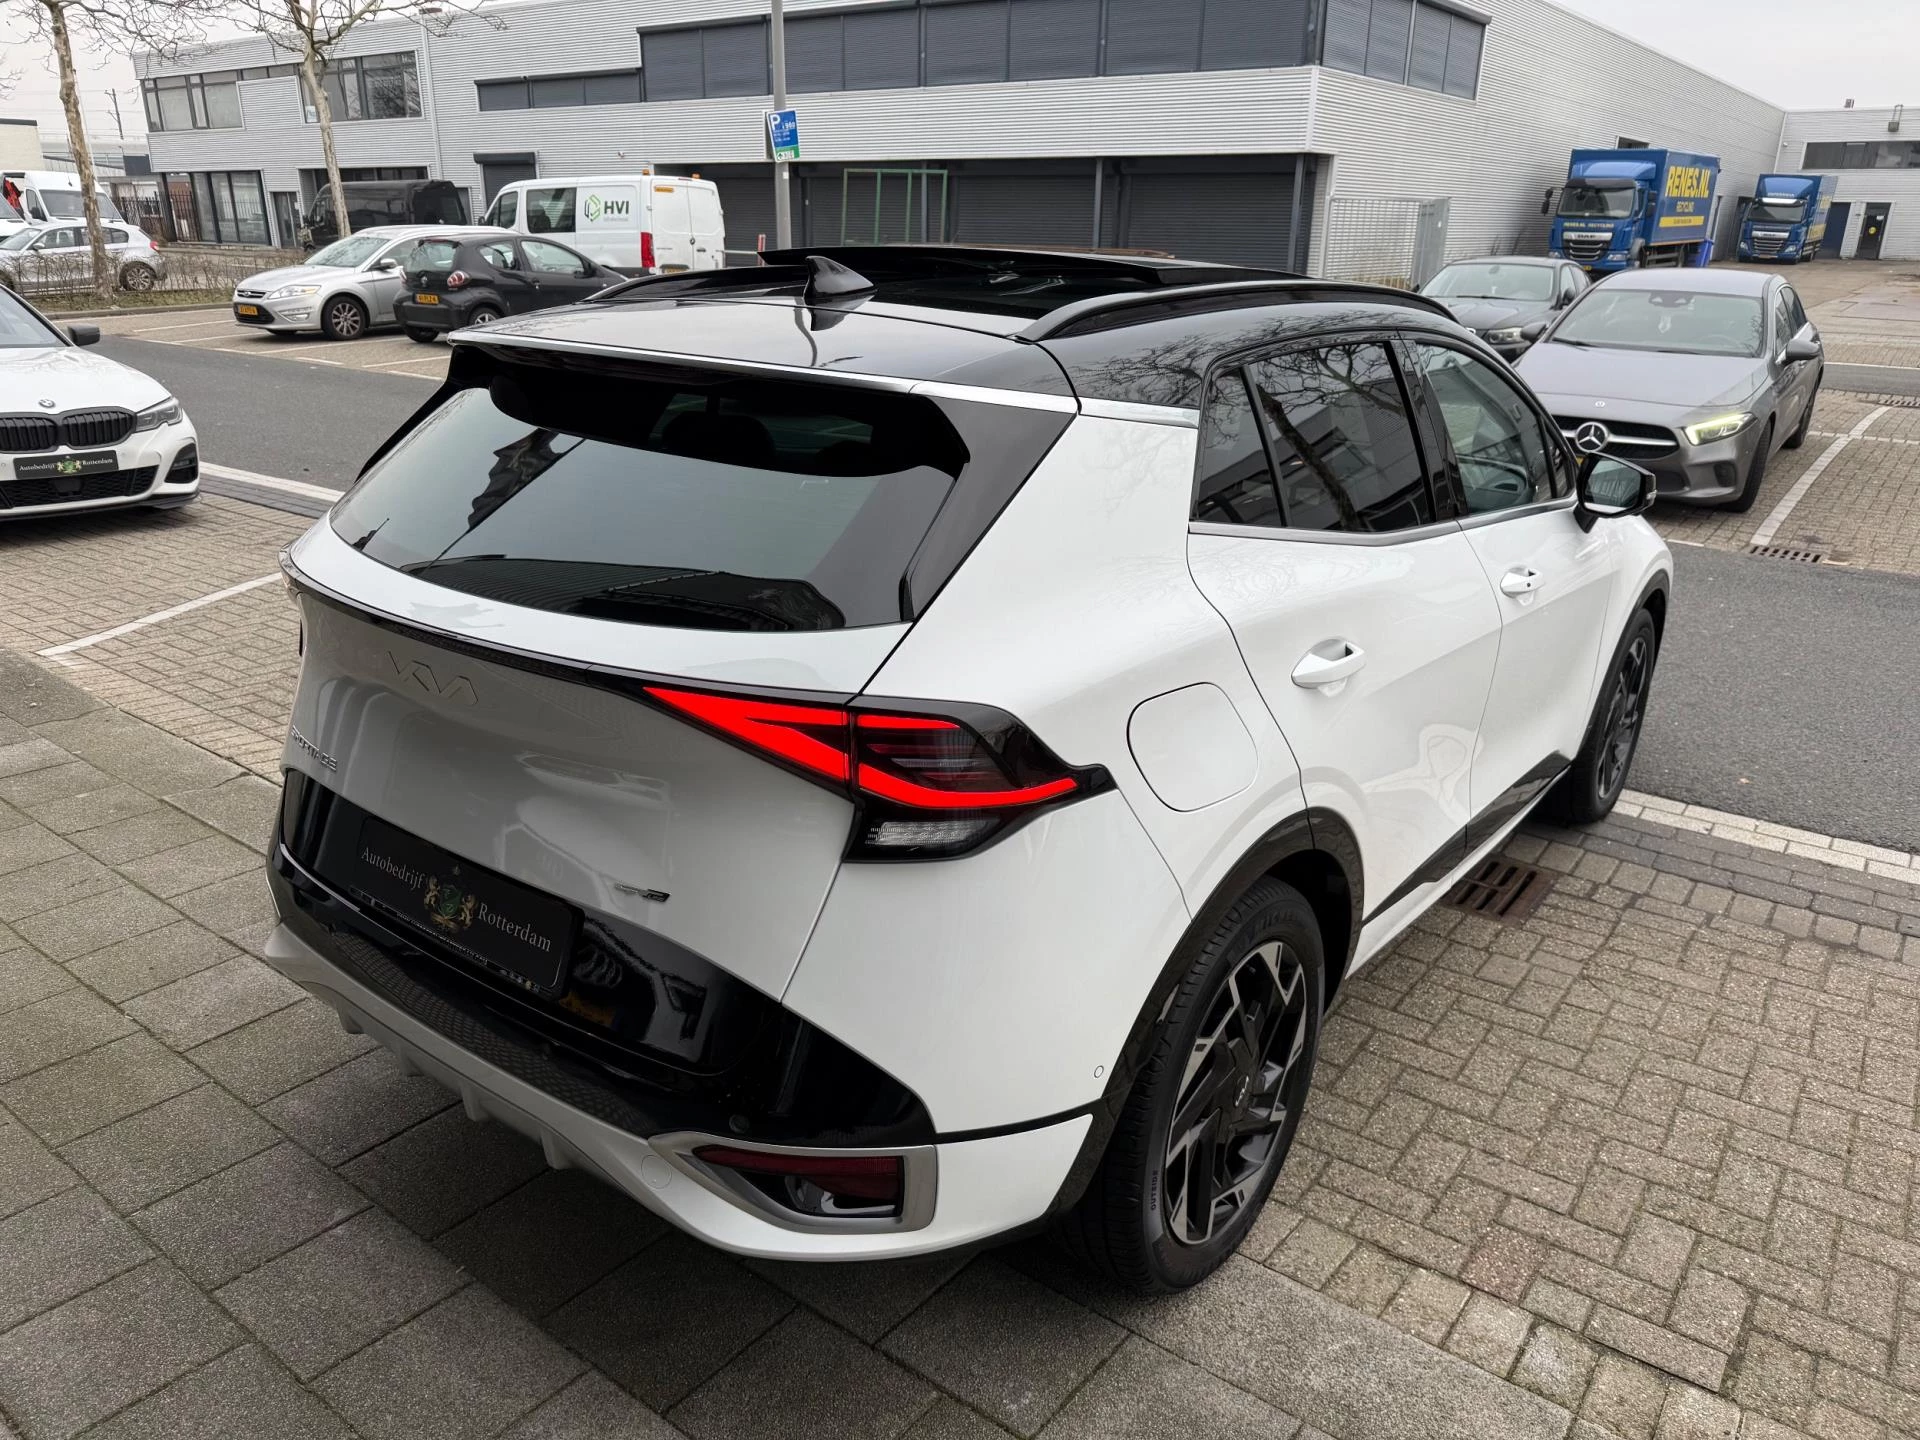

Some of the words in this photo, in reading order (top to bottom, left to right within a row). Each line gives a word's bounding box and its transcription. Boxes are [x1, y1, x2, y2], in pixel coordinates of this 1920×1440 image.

[770, 114, 781, 131] P
[1665, 165, 1711, 198] RENES.NL
[604, 200, 630, 215] HVI
[361, 846, 426, 892] Autobedrijf
[477, 901, 552, 953] Rotterdam
